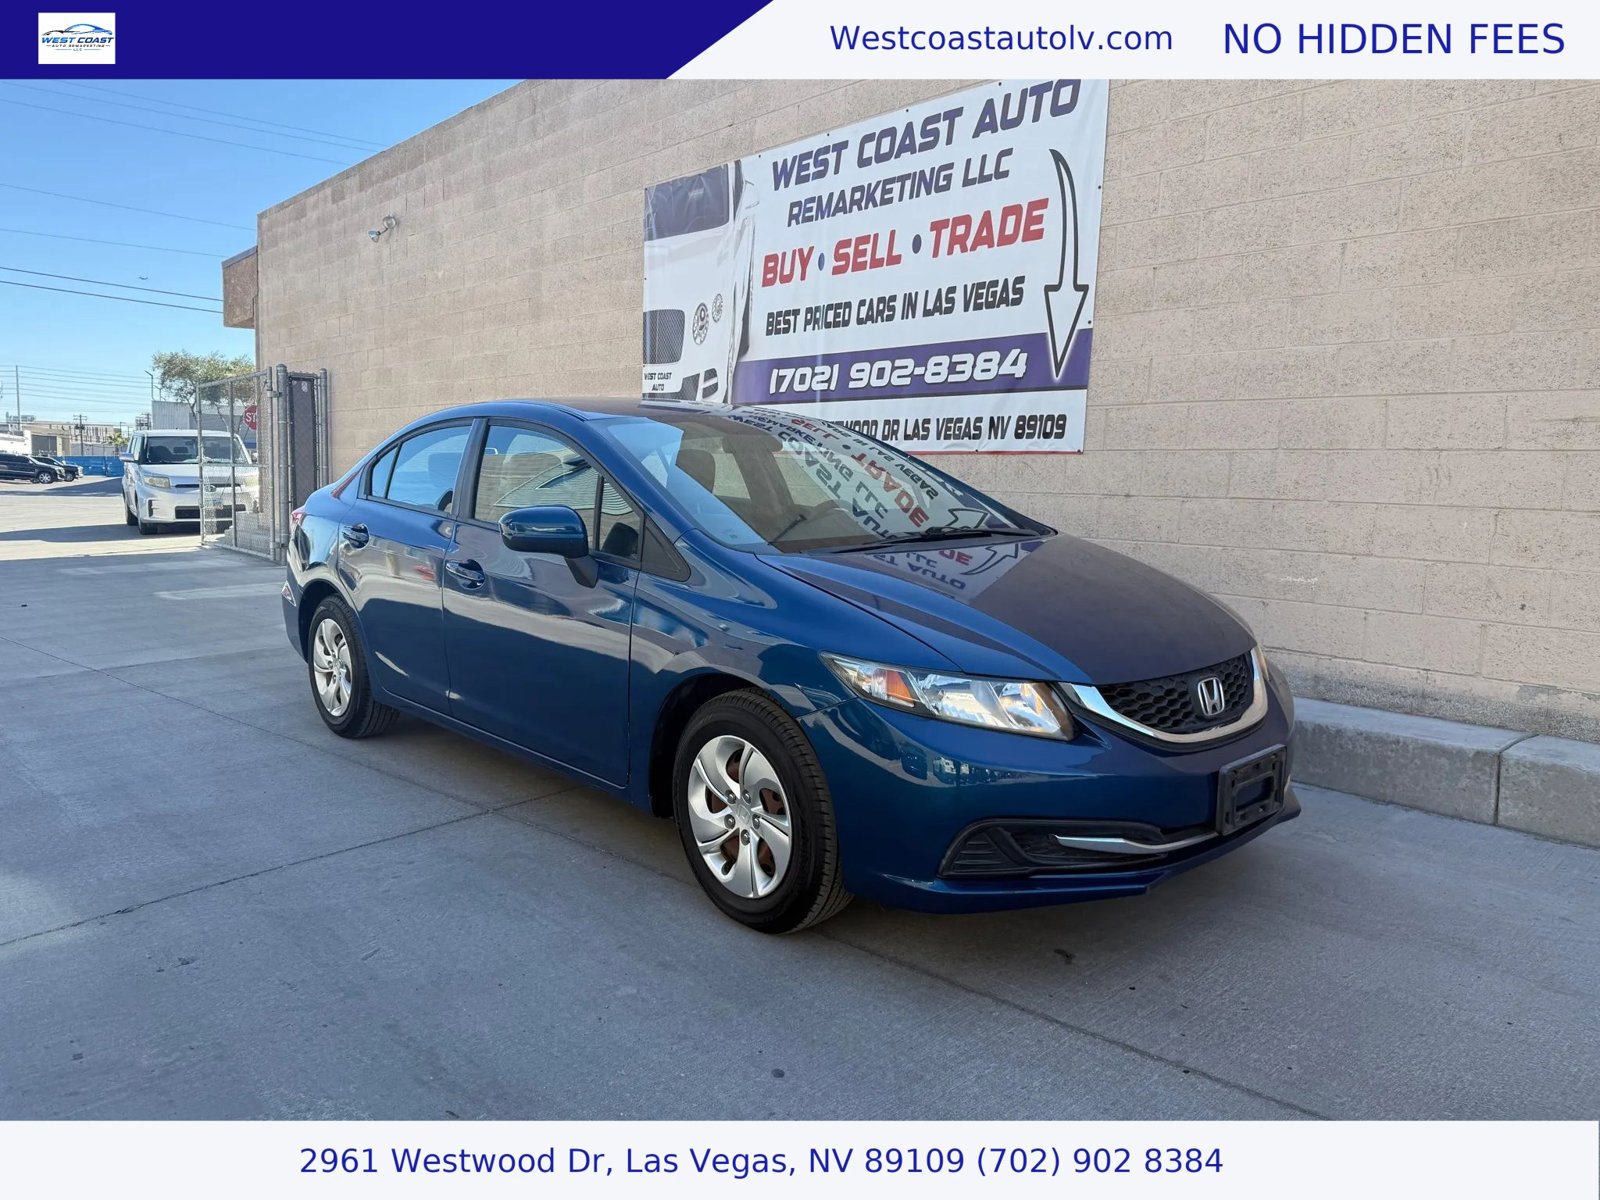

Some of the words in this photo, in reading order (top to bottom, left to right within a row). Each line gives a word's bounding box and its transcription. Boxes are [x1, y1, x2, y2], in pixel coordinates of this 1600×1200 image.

[772, 140, 849, 191] WEST
[857, 106, 964, 169] COAST
[972, 79, 1080, 139] AUTO
[787, 162, 955, 228] REMARKETING
[962, 147, 1014, 188] LLC
[762, 246, 815, 287] BUY
[832, 229, 902, 275] SELL
[930, 198, 1049, 258] TRADE
[766, 308, 801, 336] BEST
[803, 301, 852, 333] PRICED
[856, 294, 897, 325] CARS
[901, 291, 919, 320] IN
[922, 286, 957, 318] LAS
[963, 275, 1026, 313] VEGAS
[657, 372, 672, 380] COAST
[848, 349, 1028, 389] 902-8384
[881, 419, 900, 441] DR
[903, 418, 931, 441] LAS
[936, 416, 984, 441] VEGAS
[988, 415, 1012, 440] NV
[1013, 414, 1068, 440] 89109
